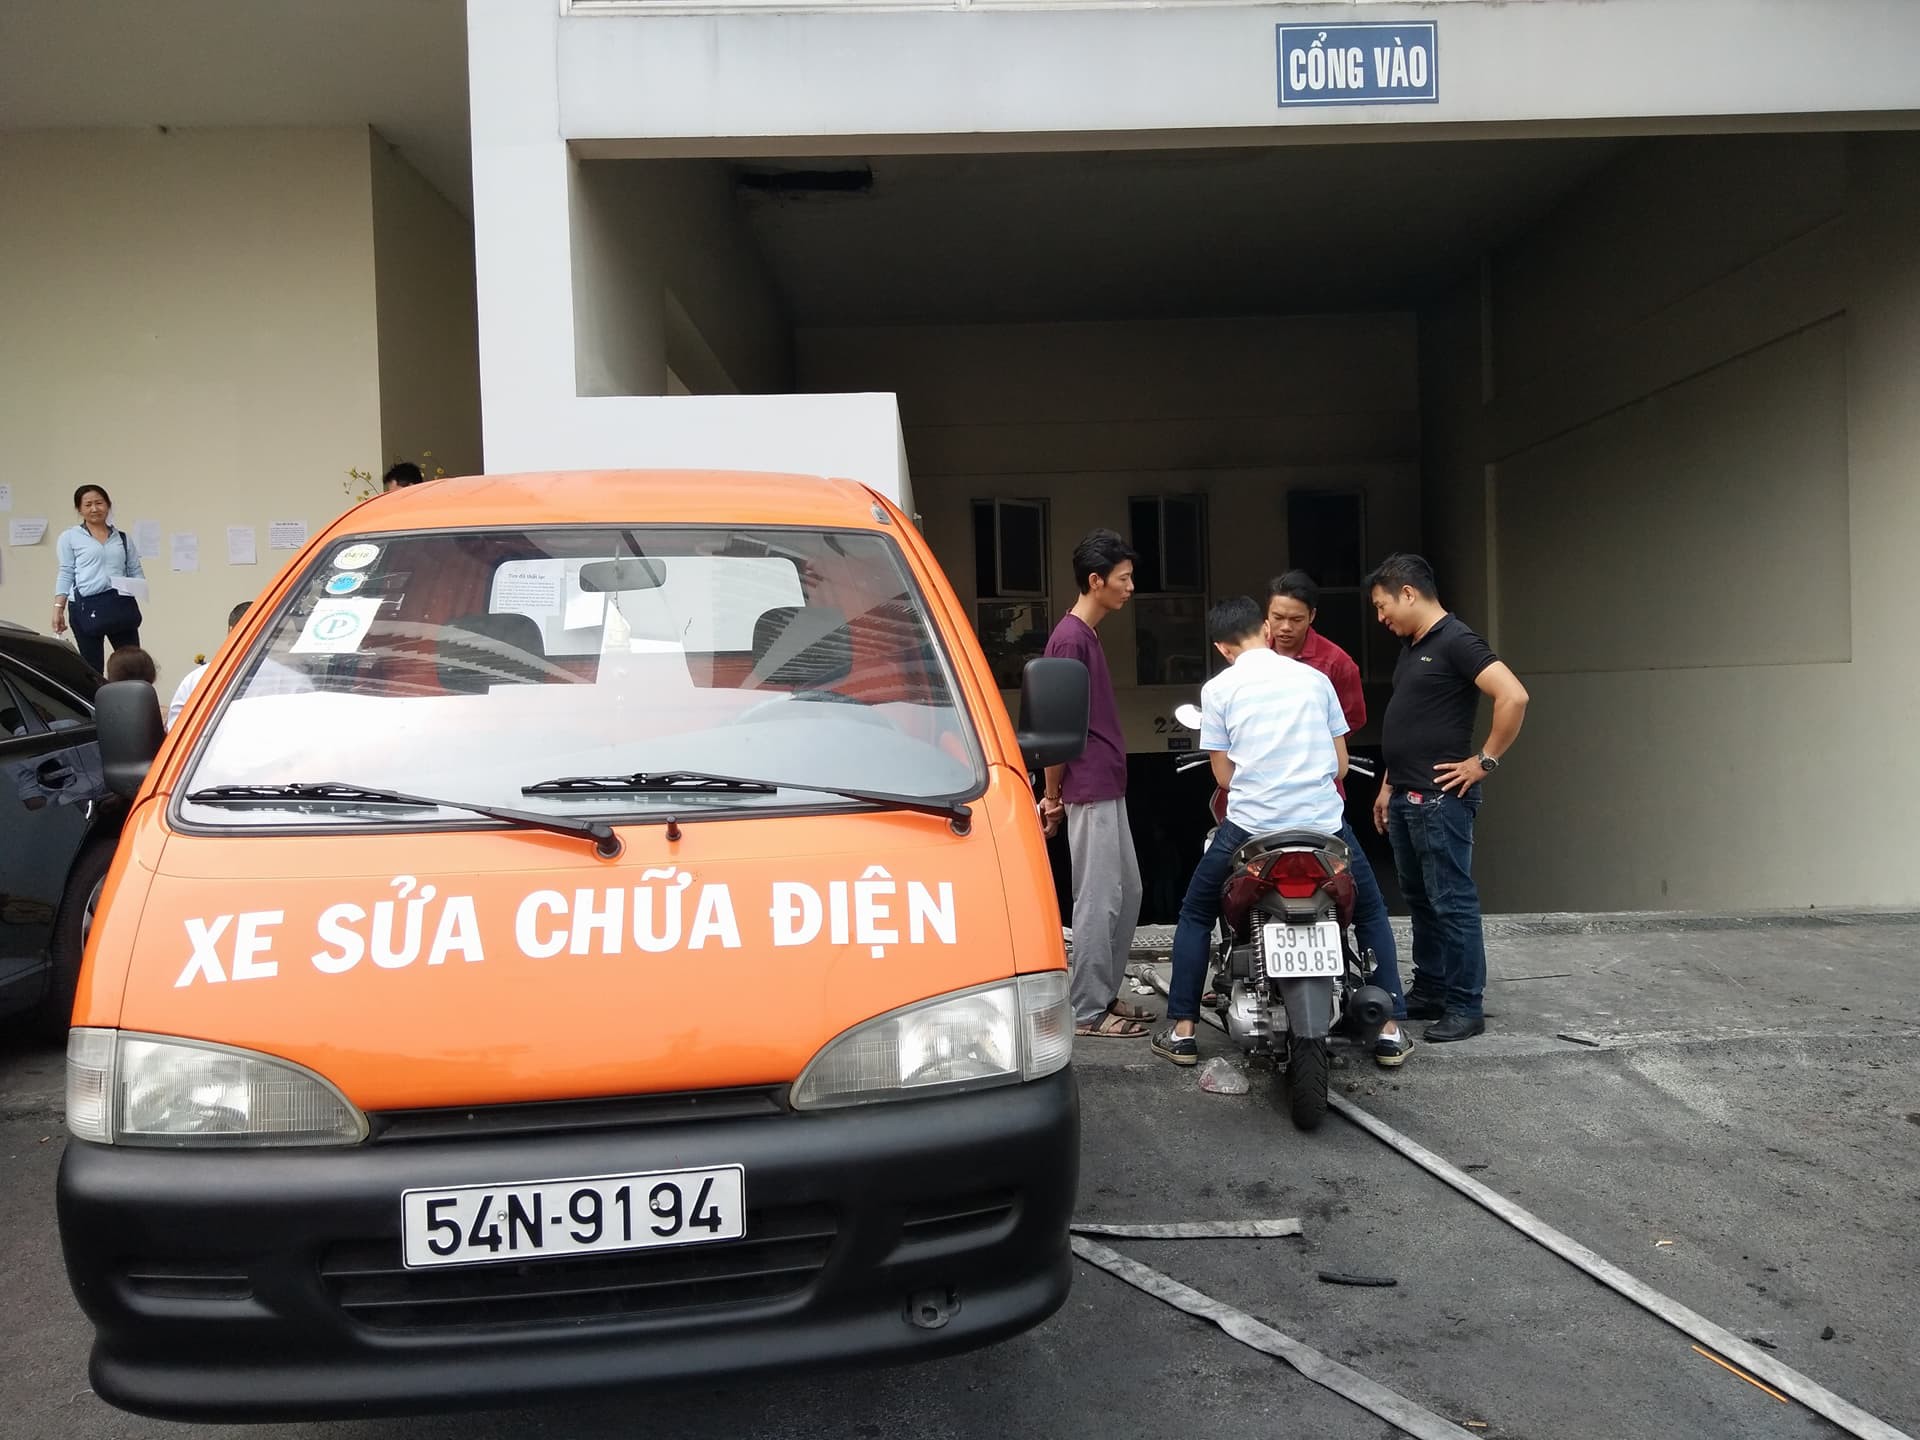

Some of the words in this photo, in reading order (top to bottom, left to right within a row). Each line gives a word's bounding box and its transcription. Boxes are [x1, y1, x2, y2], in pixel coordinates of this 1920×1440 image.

[1289, 31, 1364, 91] CỔNG
[1373, 37, 1428, 88] VÀO
[174, 910, 285, 988] XE
[311, 875, 485, 974] SỬA
[515, 866, 742, 958] CHỮA
[769, 865, 957, 959] ĐIỆN
[1272, 950, 1338, 972] 089.85
[426, 1177, 722, 1256] 54N-9194
